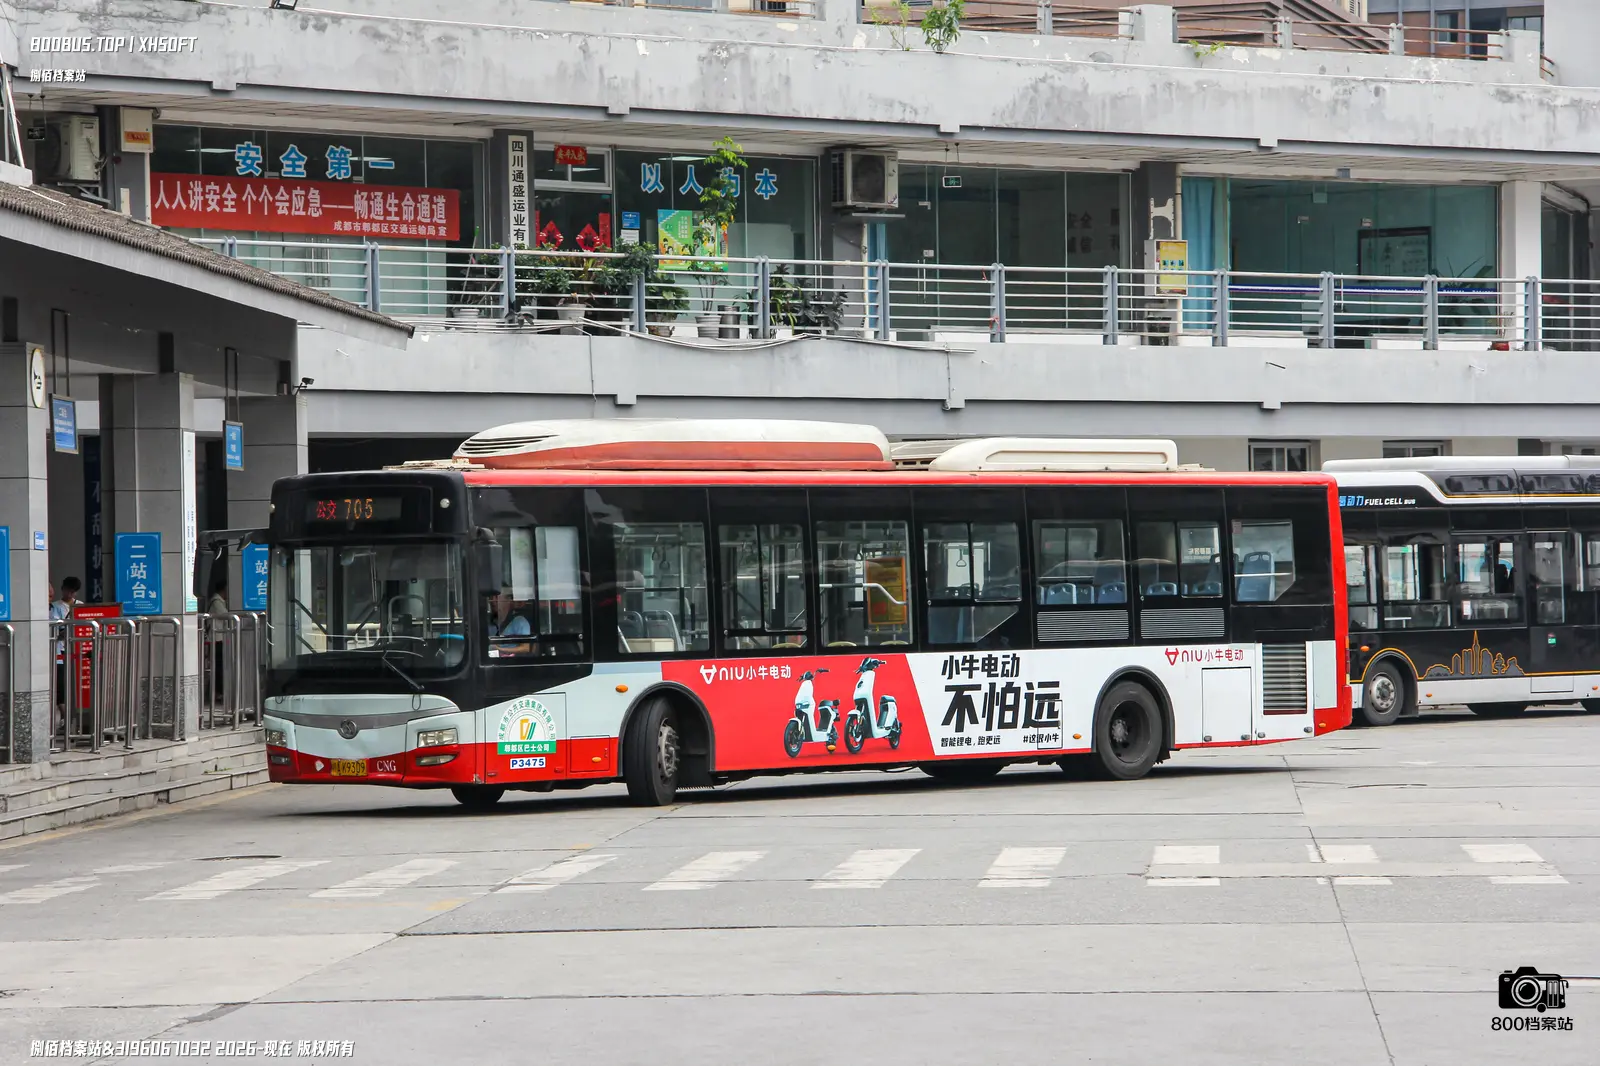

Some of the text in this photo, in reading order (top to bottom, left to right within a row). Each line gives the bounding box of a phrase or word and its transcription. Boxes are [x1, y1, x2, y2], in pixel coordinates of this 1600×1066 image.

[235, 141, 395, 180] 安全第一
[641, 162, 778, 200] 以人为本
[154, 180, 237, 213] 人人讲安全
[333, 220, 436, 236] 成都市郫都区交通运输局
[316, 498, 373, 520] 公交 705
[1364, 498, 1383, 506] FUEL
[130, 544, 148, 599] 二站台
[941, 653, 1021, 680] 小牛电动
[1204, 649, 1244, 662] 小牛电动
[746, 665, 792, 681] 小牛电动
[941, 681, 1061, 733] 不怕远
[376, 760, 397, 772] CNG
[511, 758, 545, 768] P3475
